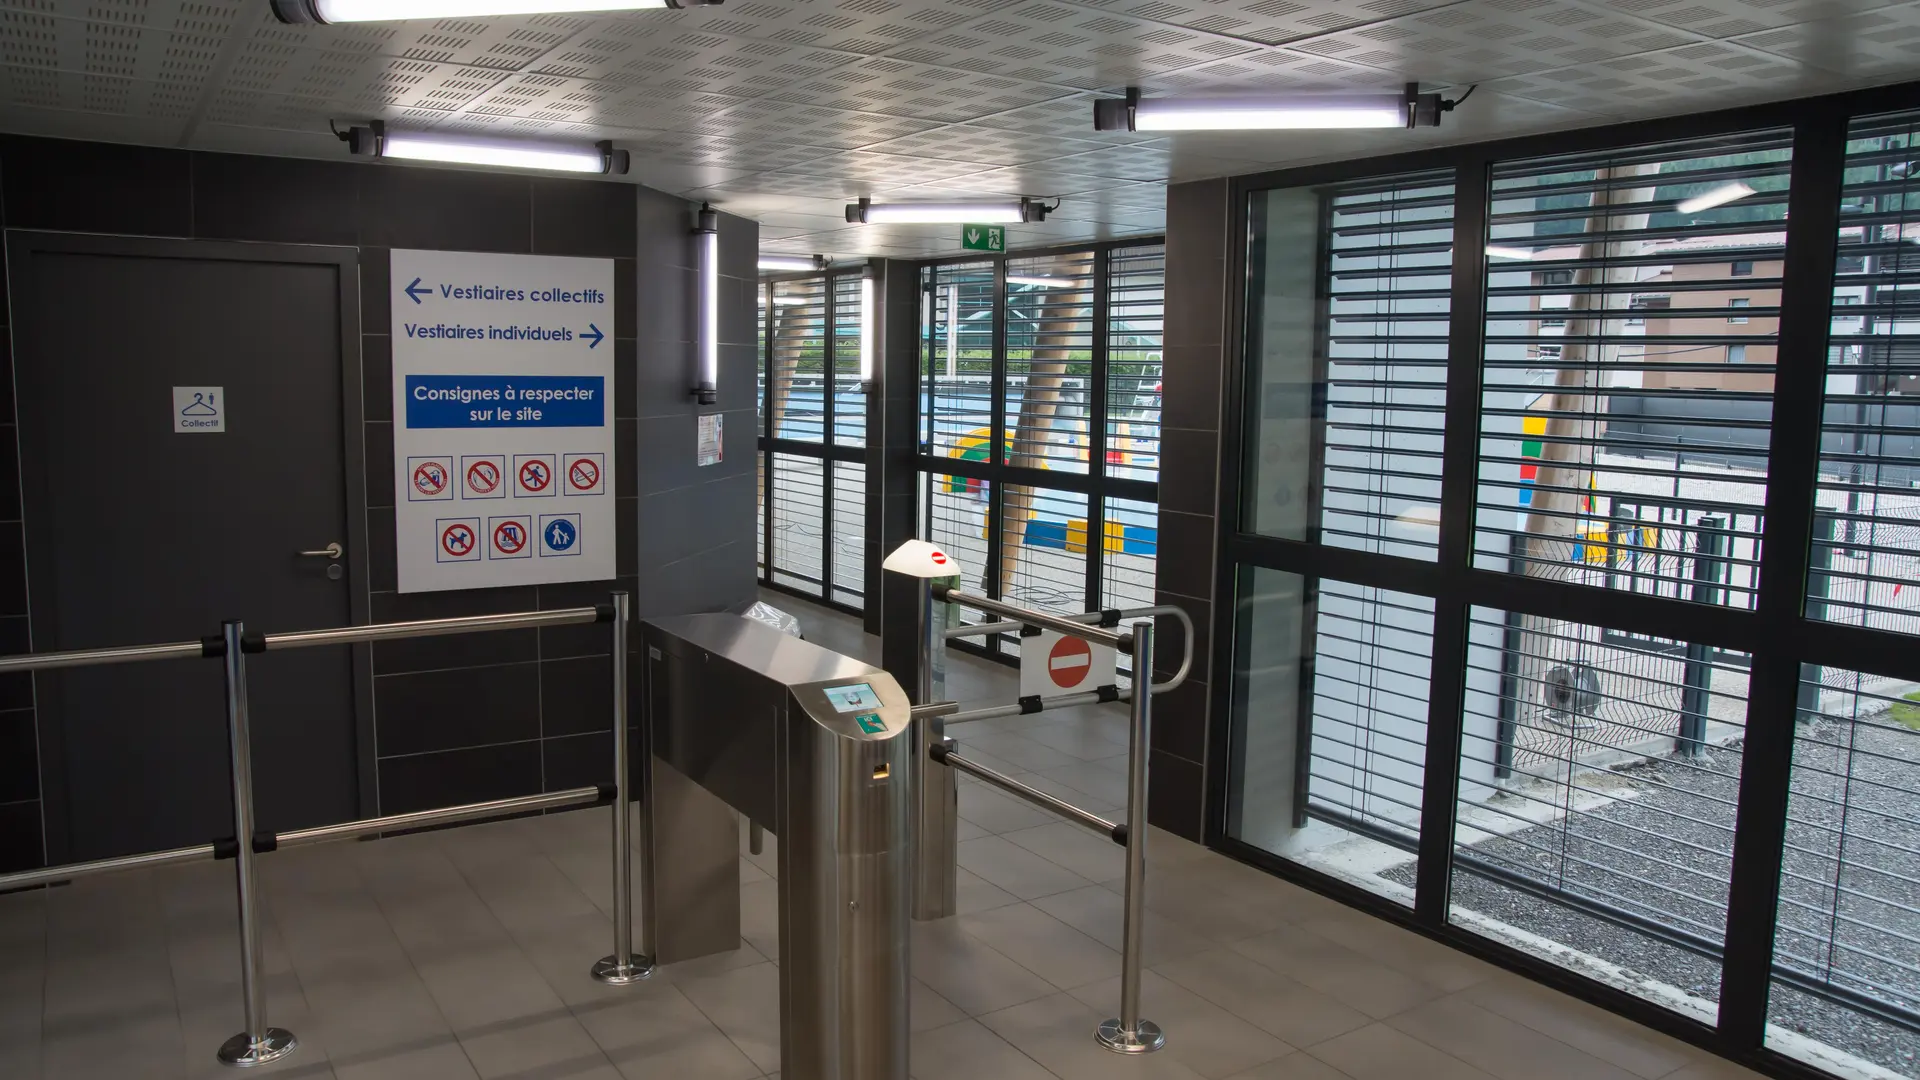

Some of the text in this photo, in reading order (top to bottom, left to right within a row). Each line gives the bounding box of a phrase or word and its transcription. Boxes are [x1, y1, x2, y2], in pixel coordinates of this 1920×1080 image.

[440, 284, 605, 304] Vestiaires collectifs
[404, 323, 573, 341] Vestiaires individuels
[414, 385, 594, 403] Consignes à respecter
[470, 407, 542, 421] sur le site
